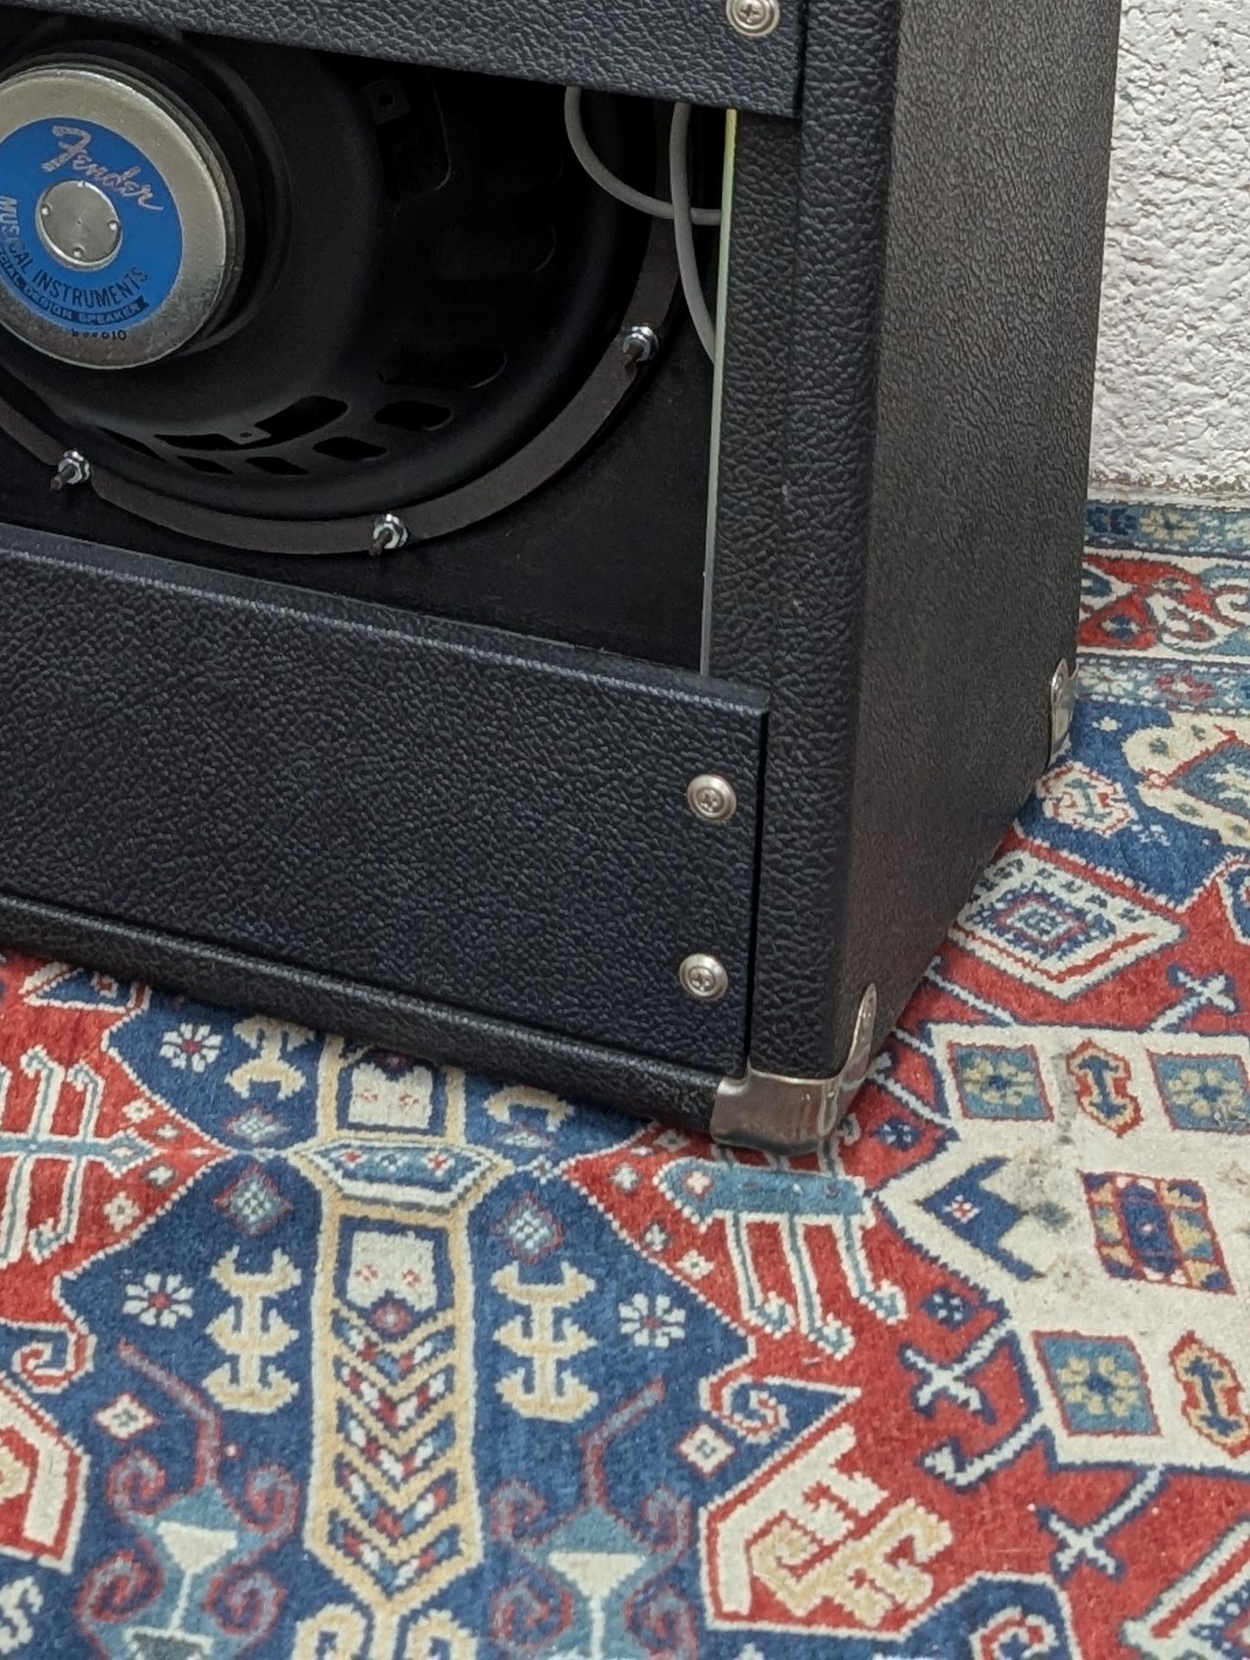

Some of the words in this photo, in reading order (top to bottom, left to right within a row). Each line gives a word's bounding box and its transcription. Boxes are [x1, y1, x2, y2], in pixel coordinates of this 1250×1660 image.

[41, 125, 165, 211] Fender
[32, 266, 149, 309] INSTRUMENTS
[78, 301, 141, 325] SPEAKER
